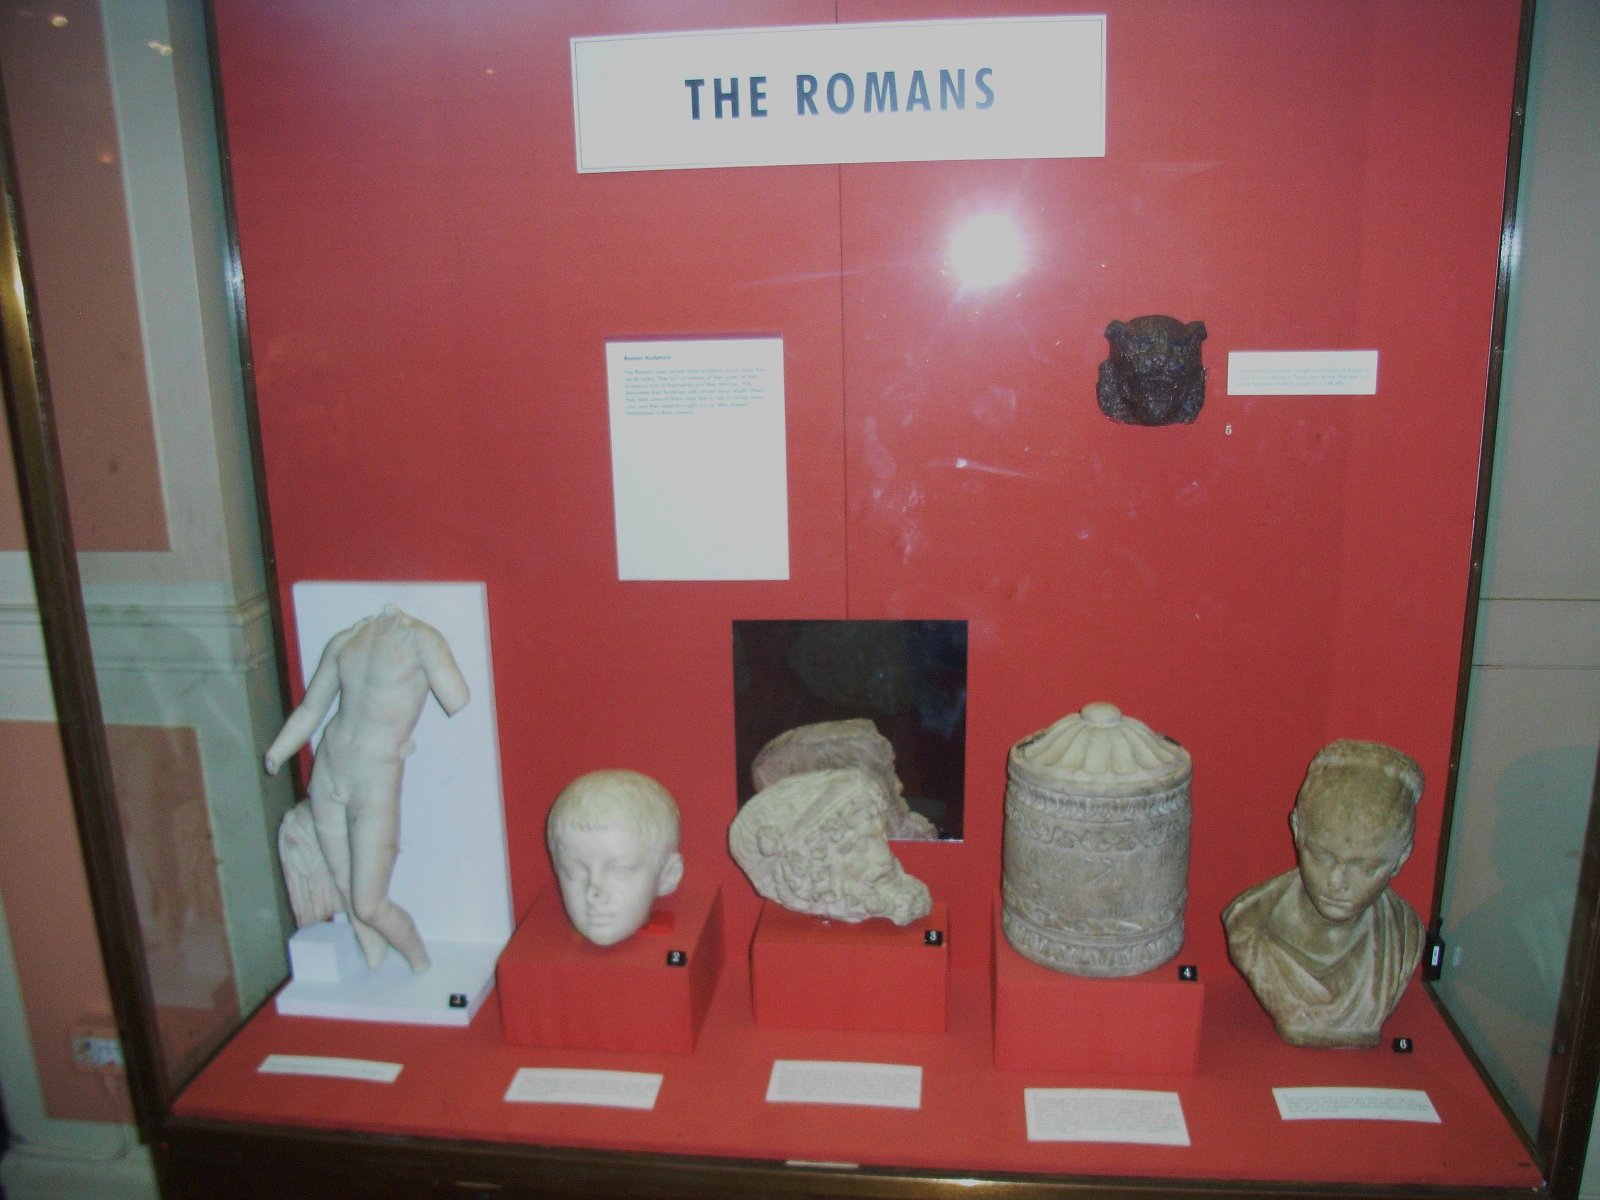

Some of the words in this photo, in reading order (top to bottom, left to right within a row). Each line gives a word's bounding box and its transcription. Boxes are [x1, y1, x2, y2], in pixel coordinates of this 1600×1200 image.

[684, 76, 768, 120] THE
[796, 67, 996, 116] ROMANS
[1183, 967, 1191, 978] 4
